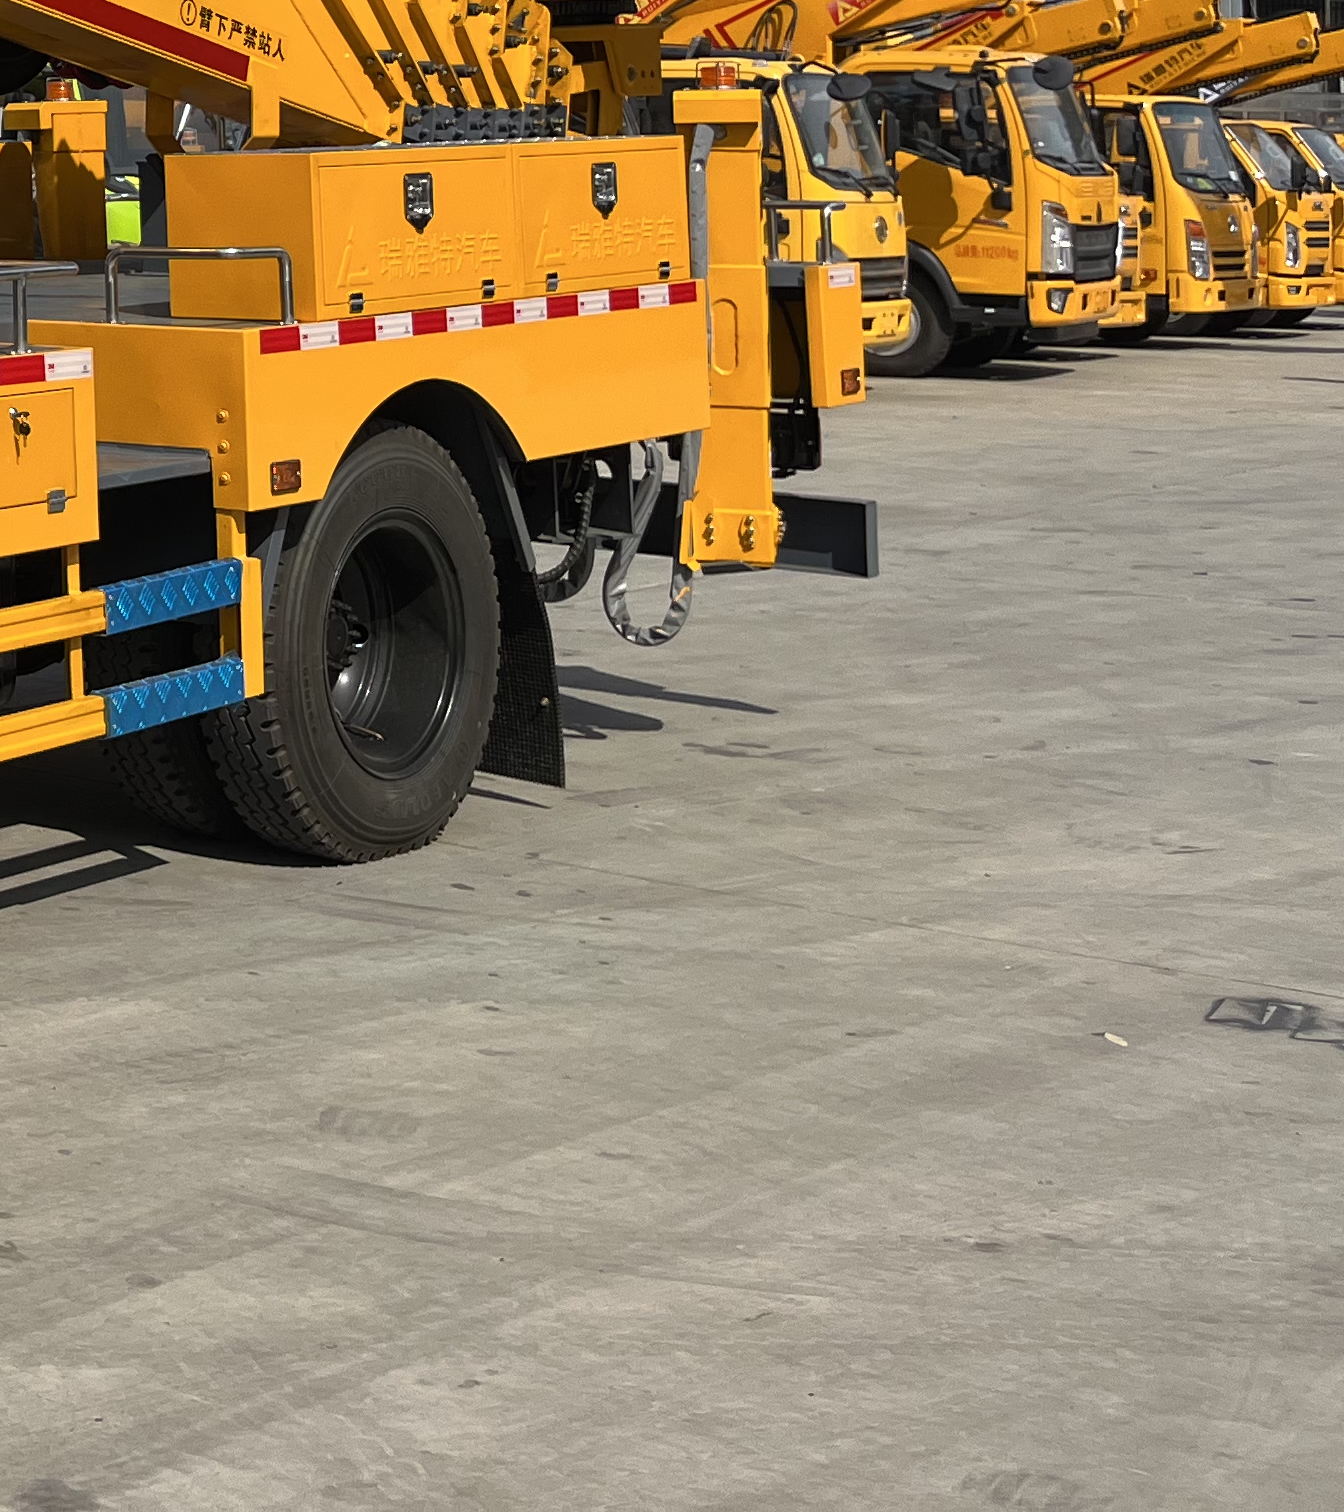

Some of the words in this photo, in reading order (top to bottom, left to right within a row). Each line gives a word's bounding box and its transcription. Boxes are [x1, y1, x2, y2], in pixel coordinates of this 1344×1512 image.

[198, 5, 285, 63] 臂下严禁站人
[378, 228, 503, 282] 瑞雅特汽车
[569, 214, 676, 262] 瑞雅特汽车
